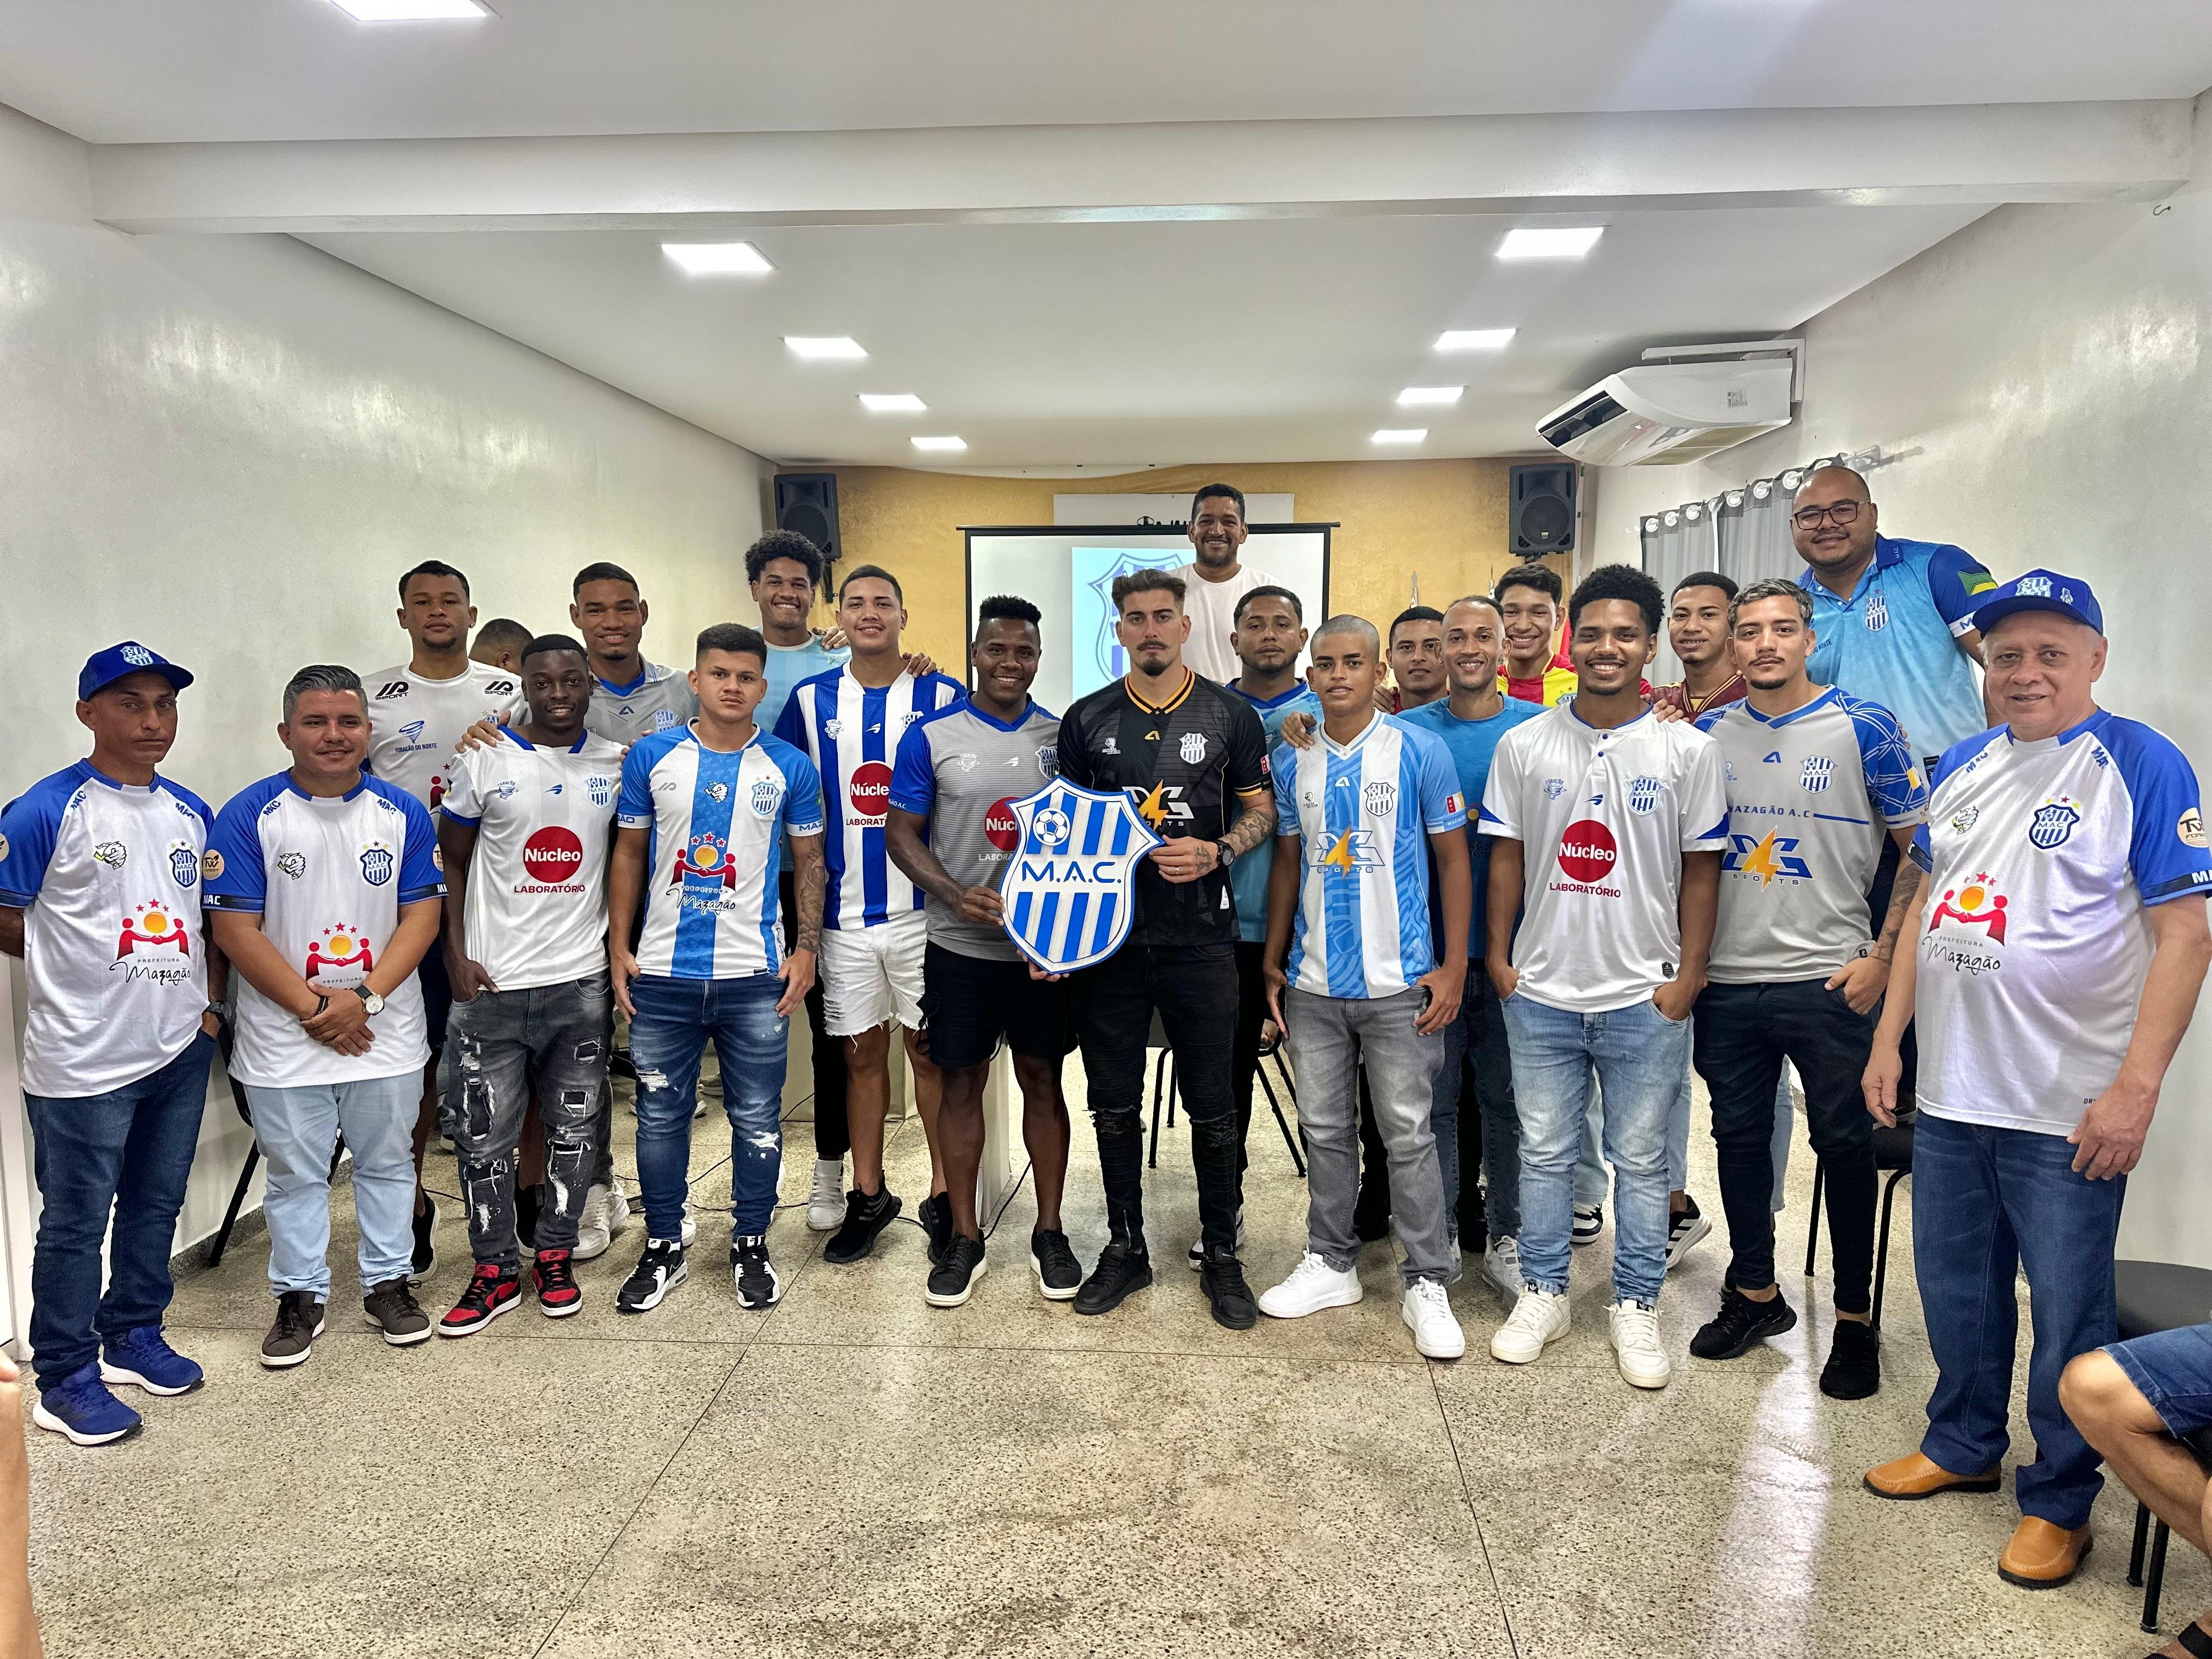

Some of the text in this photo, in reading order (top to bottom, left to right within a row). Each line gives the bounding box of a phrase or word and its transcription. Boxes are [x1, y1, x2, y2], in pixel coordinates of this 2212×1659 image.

[1867, 607, 1884, 617] MAC
[375, 692, 409, 700] SPORT
[851, 782, 889, 796] Núcle
[524, 847, 581, 862] Núcleo
[1559, 842, 1615, 861] Núcleo
[1022, 860, 1122, 884] M.A.C.
[514, 883, 585, 893] LABORATÓRIO
[681, 885, 729, 893] PREFEITURA
[1549, 883, 1621, 898] LABORATÓRIO
[203, 894, 221, 905] MAC
[665, 888, 736, 916] Mazagão
[1939, 935, 1983, 947] PREFEITURA
[1922, 936, 2001, 975] Mazagão
[109, 961, 191, 986] Mazagão
